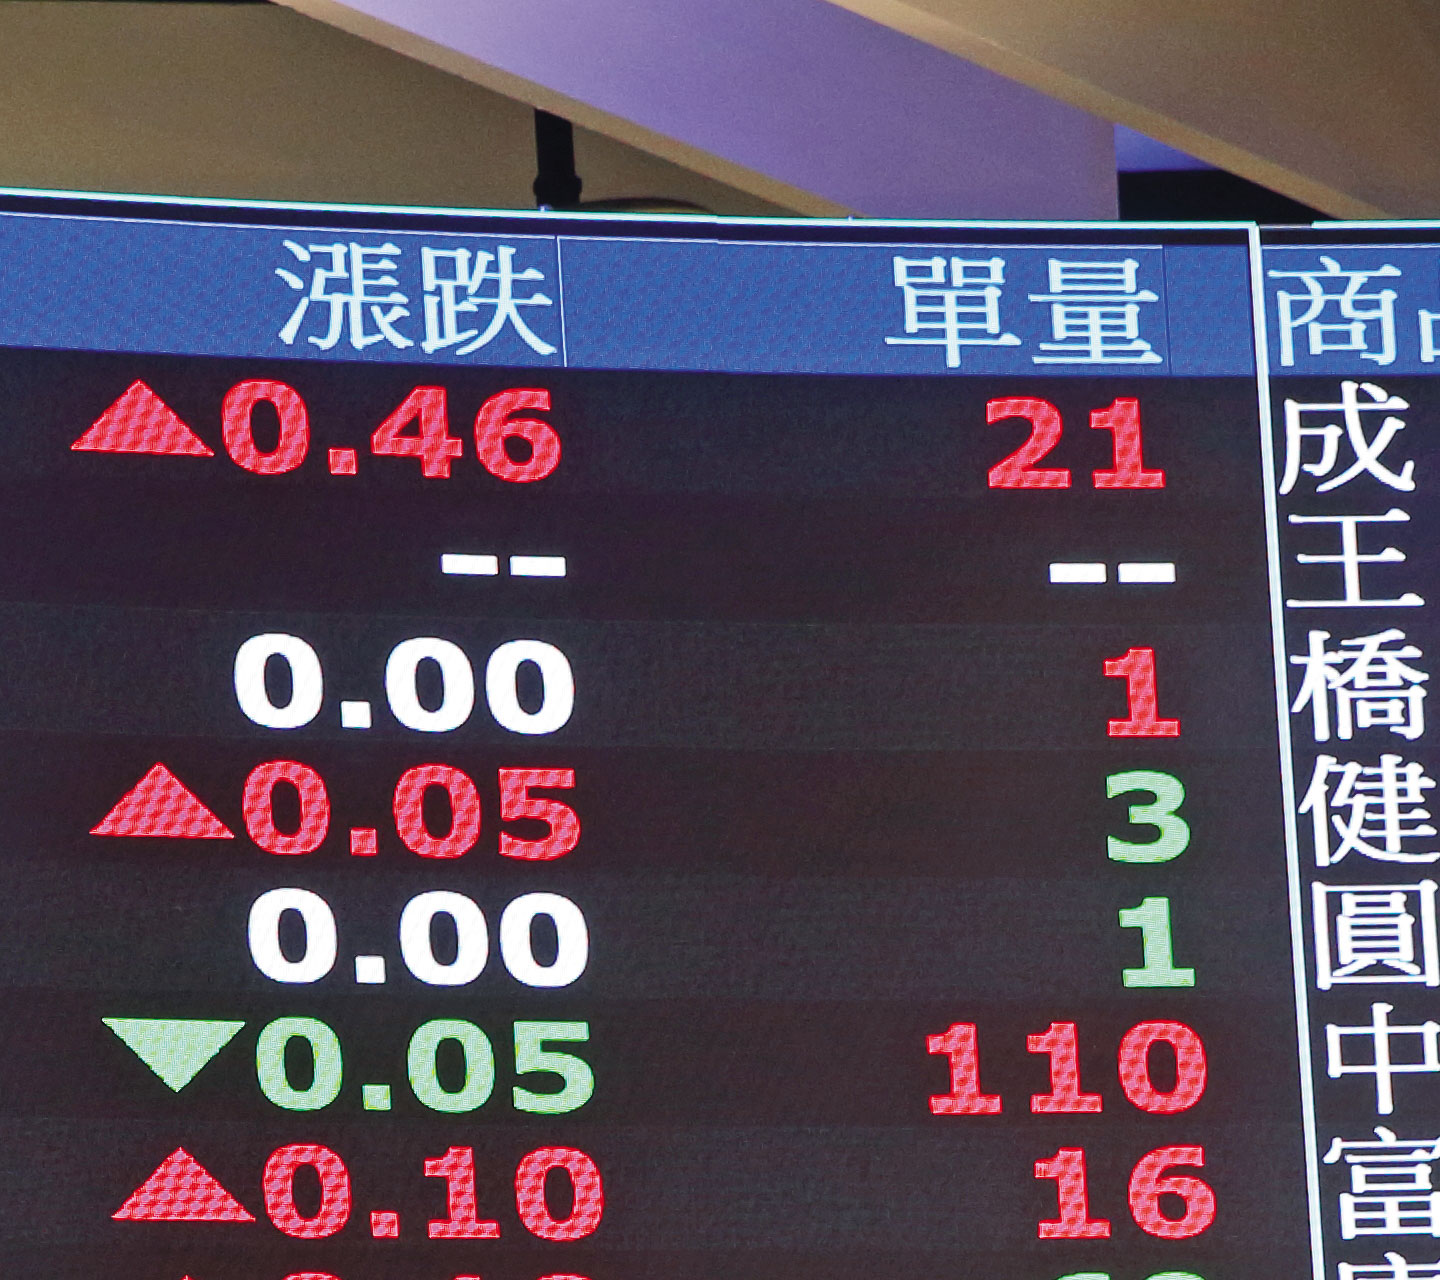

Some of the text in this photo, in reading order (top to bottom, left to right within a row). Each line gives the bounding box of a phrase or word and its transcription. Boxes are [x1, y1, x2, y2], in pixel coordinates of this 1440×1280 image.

[274, 238, 558, 356] 漲跌
[887, 257, 1162, 367] 單量
[221, 379, 561, 483] 0.46
[986, 396, 1166, 489] 21
[1279, 381, 1415, 494] 成
[1286, 509, 1425, 607] 王
[234, 634, 574, 734] 0.00
[1103, 647, 1181, 737] 1
[242, 760, 581, 861] 0.05
[1107, 770, 1190, 863] 3
[248, 888, 588, 987] 0.00
[1119, 897, 1195, 987] 1
[256, 1017, 594, 1114] 0.05
[925, 1019, 1208, 1115] 110
[262, 1143, 604, 1242] 0.10
[1034, 1144, 1216, 1240] 16
